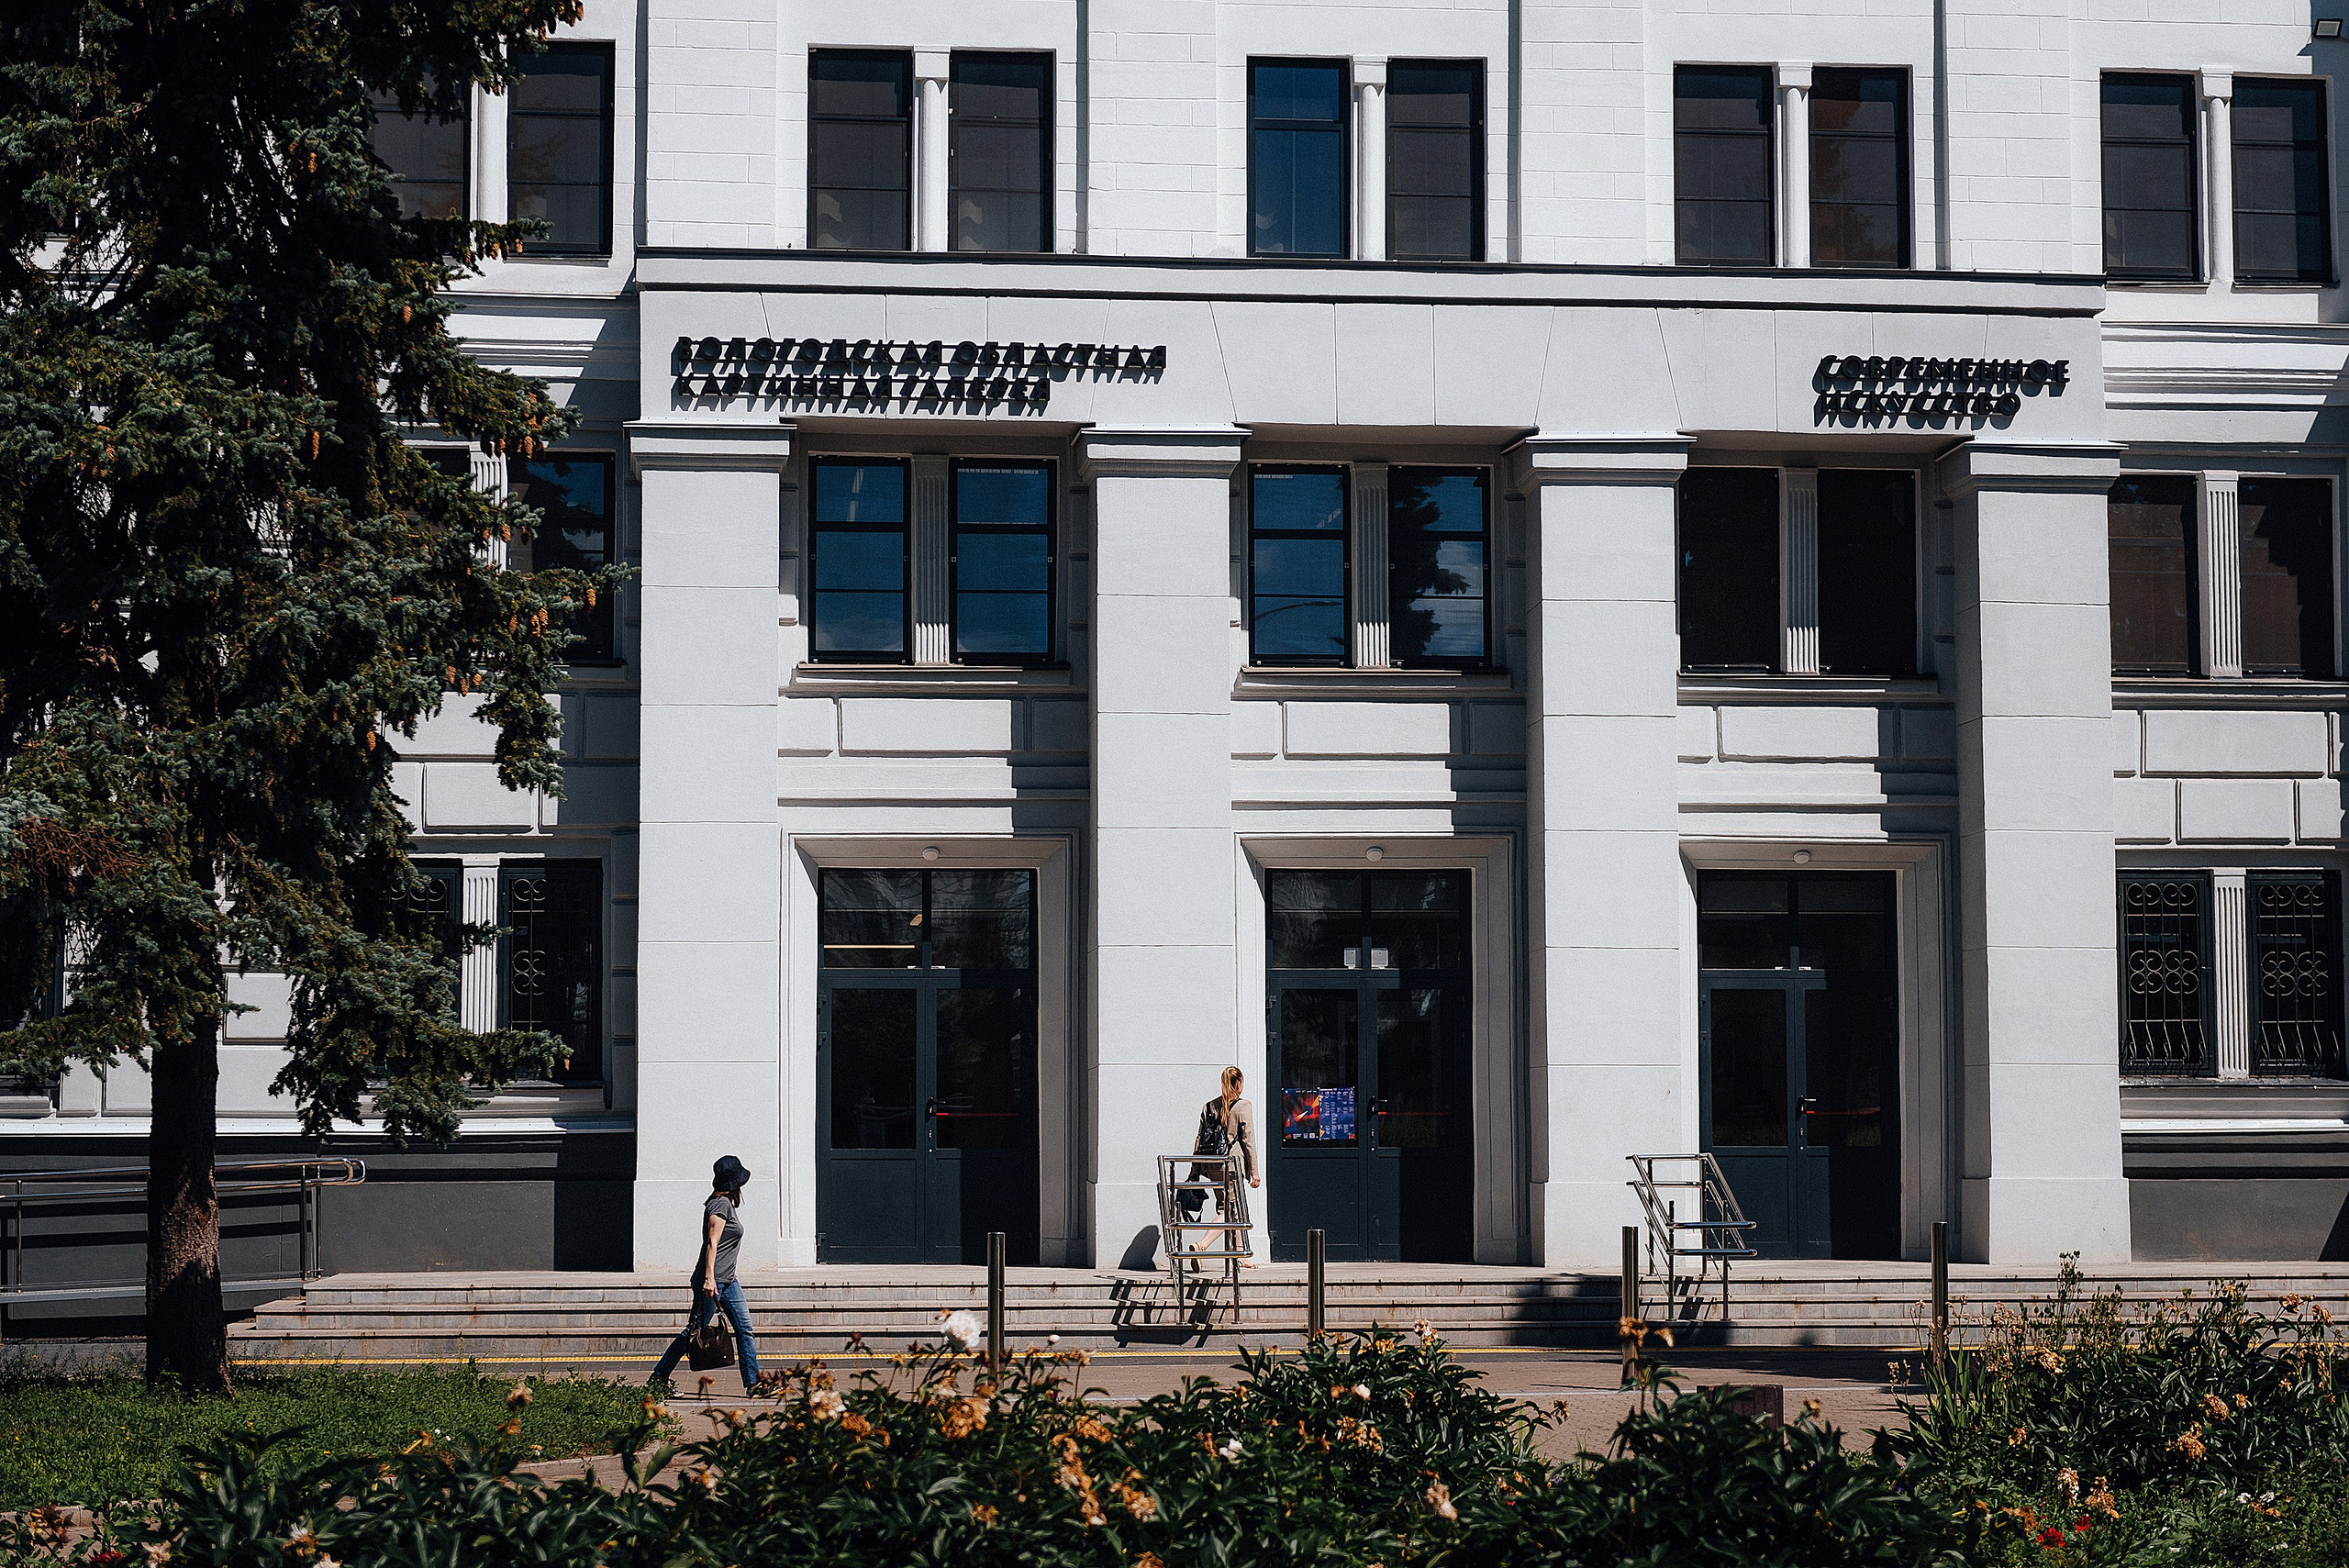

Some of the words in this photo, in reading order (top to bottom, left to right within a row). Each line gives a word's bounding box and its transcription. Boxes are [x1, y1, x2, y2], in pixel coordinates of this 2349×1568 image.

[678, 337, 942, 365] ВОЛОГОДСКАЯ
[954, 341, 1166, 369] ОБЛАСТНАЯ
[1820, 355, 2070, 384] СОВРЕМЕННОЕ
[677, 373, 893, 399] КАРТИННАЯ
[907, 376, 1050, 401] ГАЛЕРЕЯ
[1821, 390, 2021, 416] ИСКУССТВО
